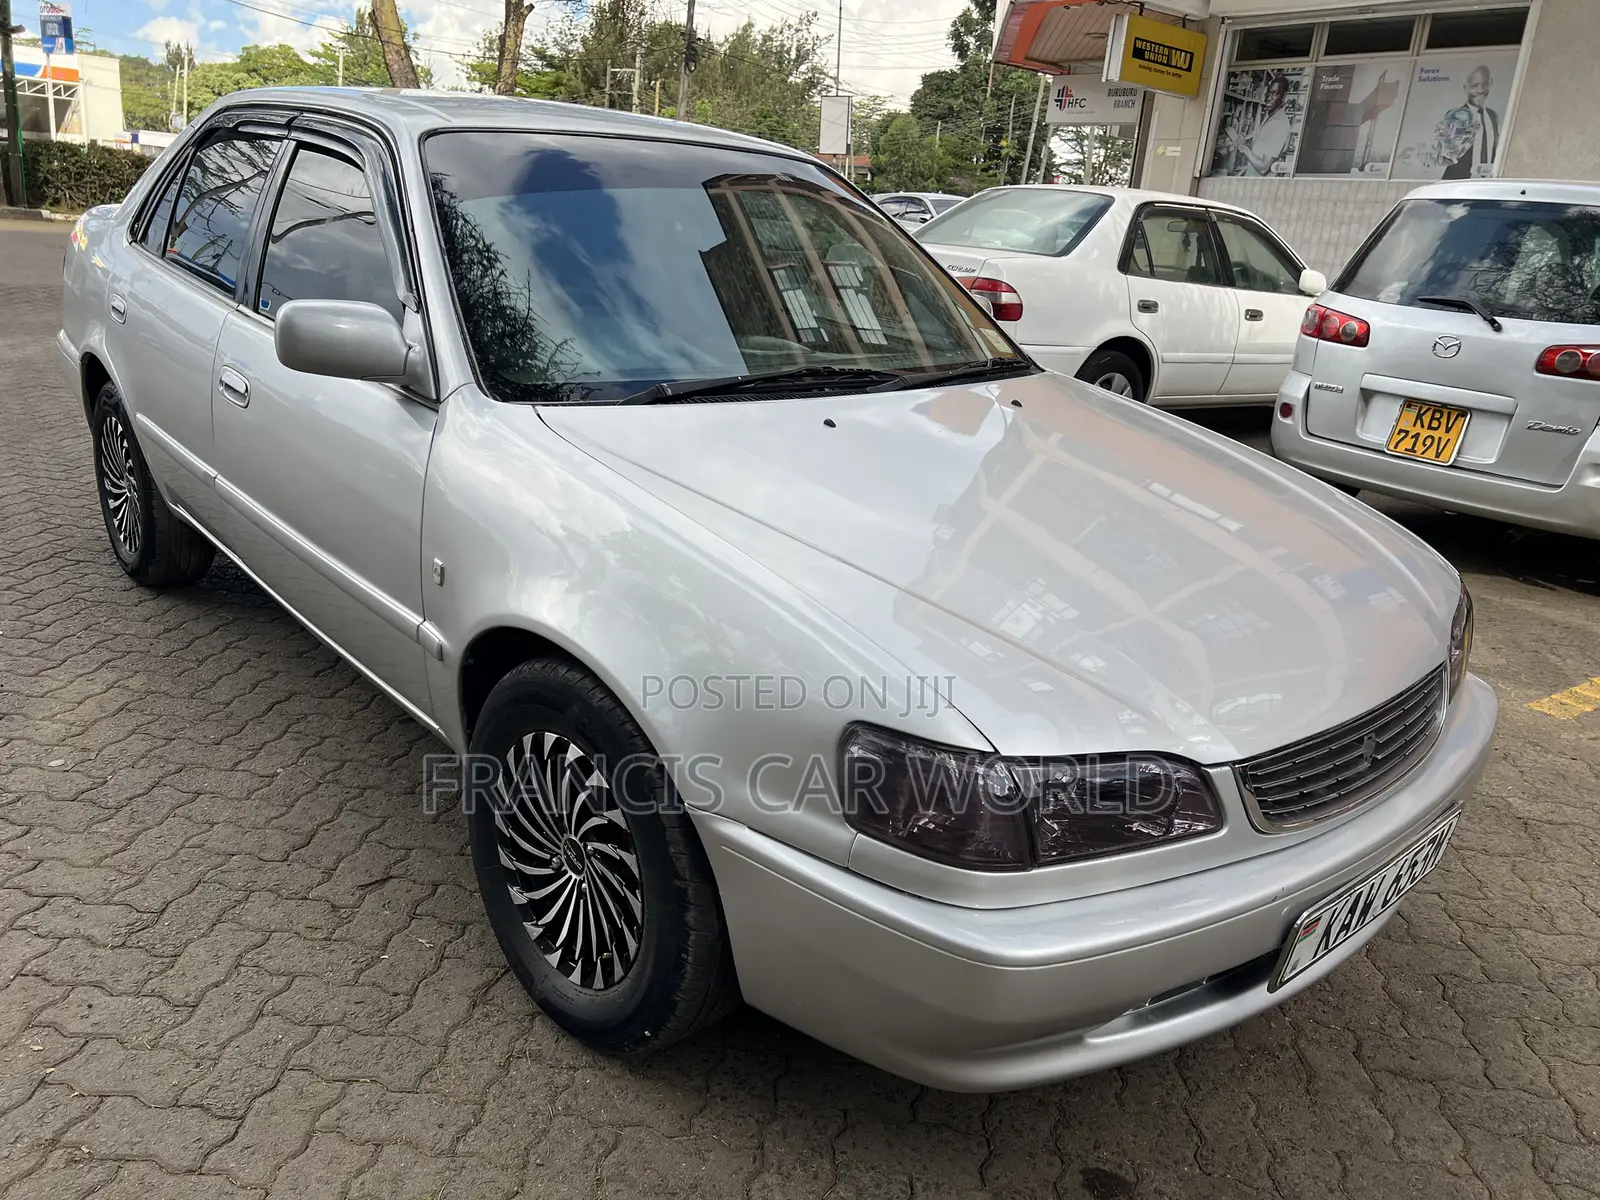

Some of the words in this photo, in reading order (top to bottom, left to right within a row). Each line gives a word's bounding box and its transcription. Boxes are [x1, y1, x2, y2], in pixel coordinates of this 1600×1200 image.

[1135, 39, 1169, 55] WESTERN
[1144, 50, 1168, 64] UNION
[1171, 49, 1191, 69] WU
[1107, 88, 1138, 97] BURUBURU
[1067, 98, 1087, 108] HFC
[1113, 99, 1136, 109] BRANCH
[1412, 405, 1461, 434] KBV
[1393, 428, 1451, 459] 719V
[1312, 873, 1386, 960] KAW
